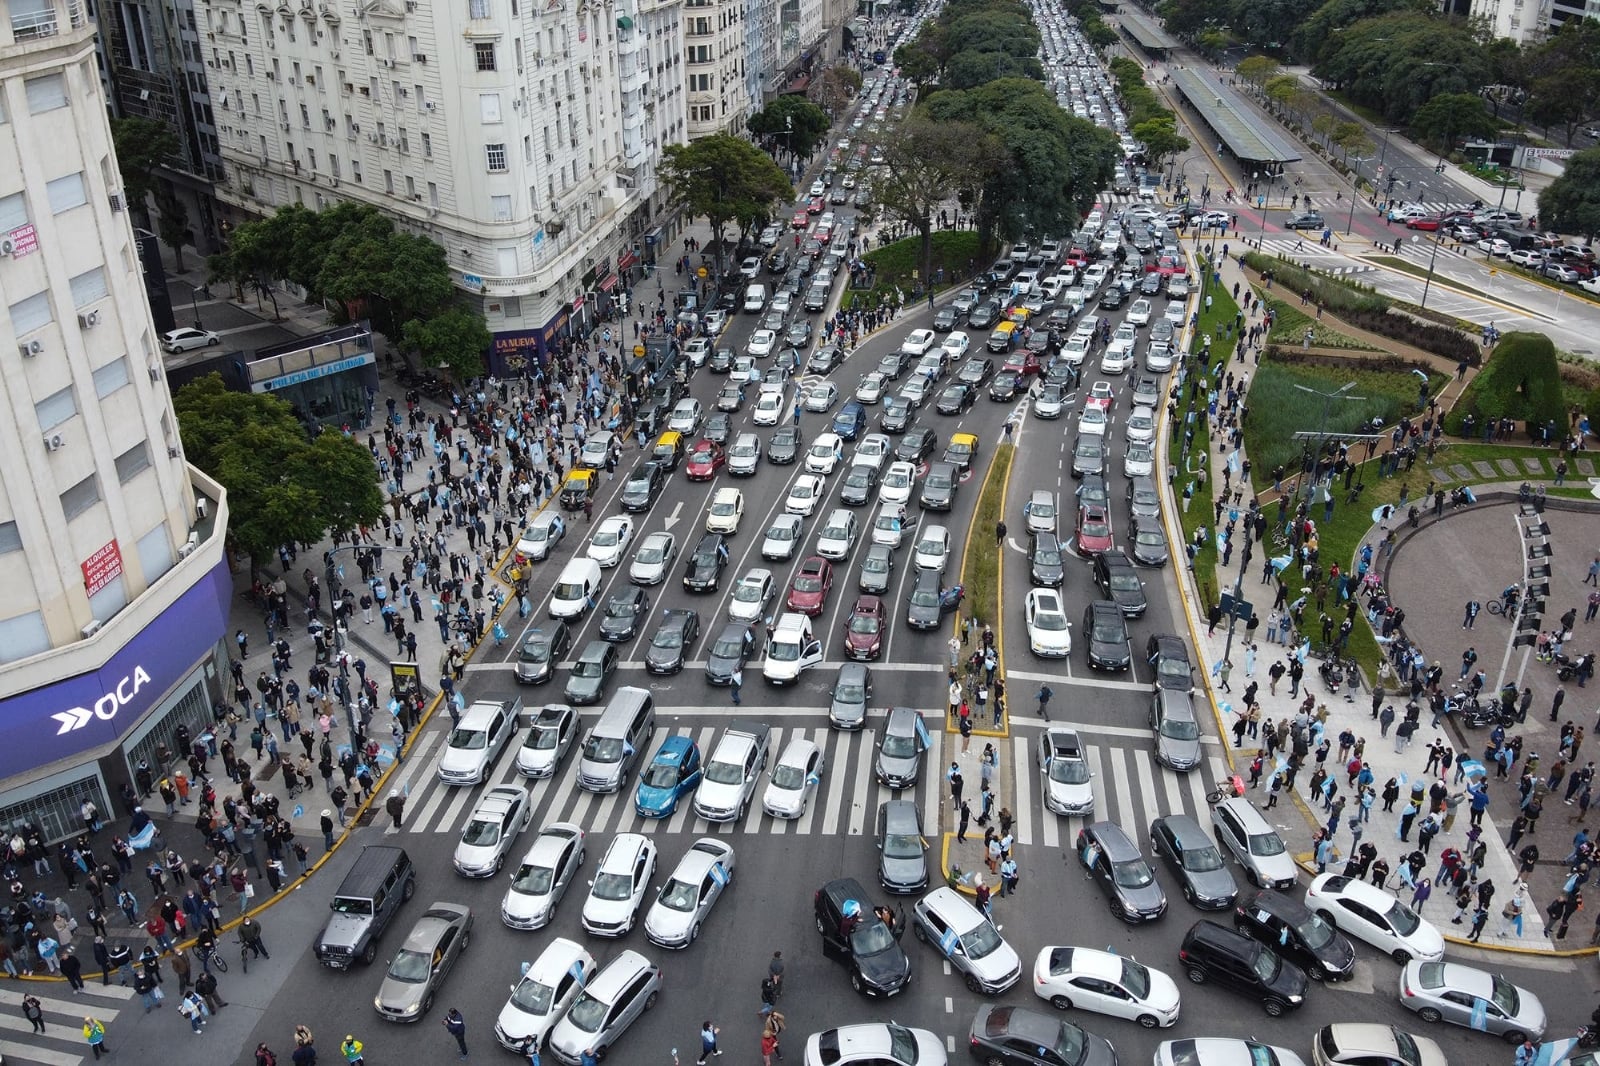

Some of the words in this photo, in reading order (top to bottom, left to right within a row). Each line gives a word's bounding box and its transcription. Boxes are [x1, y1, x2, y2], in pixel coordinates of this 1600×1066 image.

[496, 339, 507, 348] LA
[508, 337, 536, 347] NUEVA
[308, 368, 320, 379] DE
[321, 365, 334, 376] LA
[87, 543, 113, 568] ALQUILER
[87, 583, 100, 597] LOCAL
[95, 665, 151, 720] OCA
